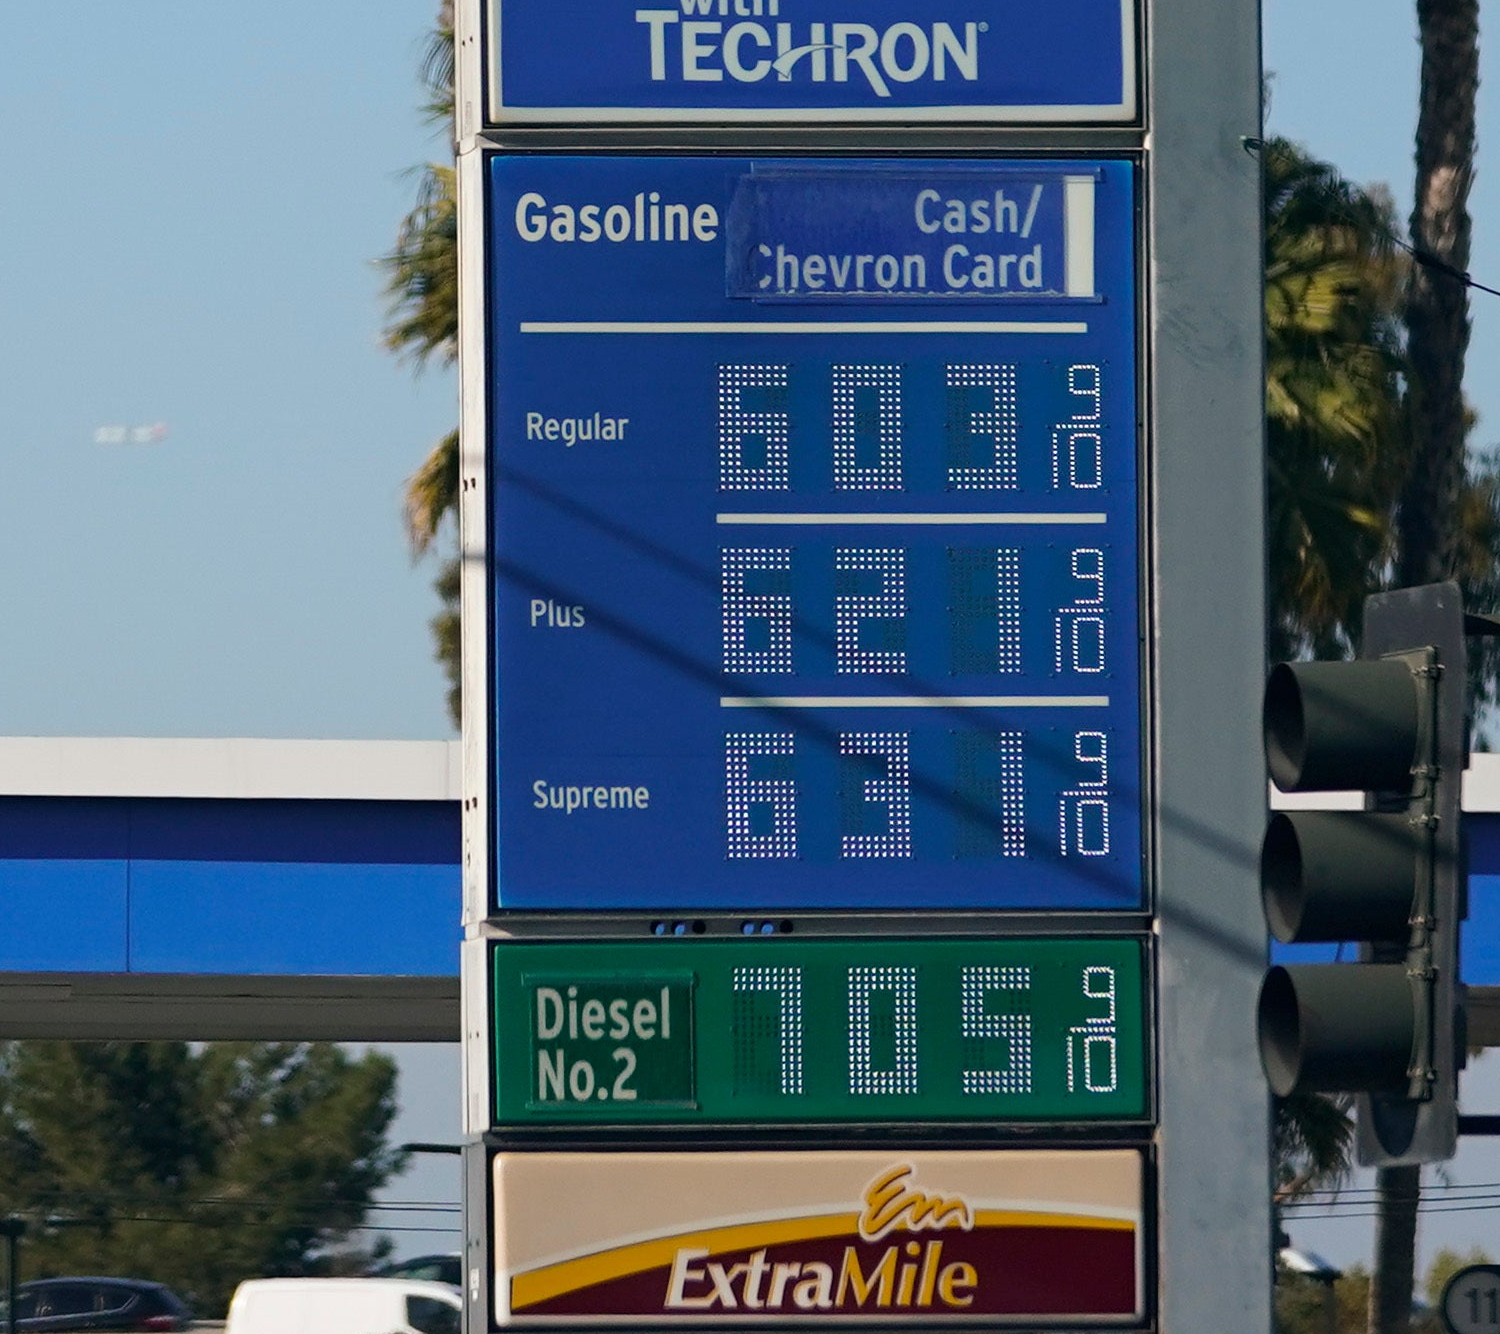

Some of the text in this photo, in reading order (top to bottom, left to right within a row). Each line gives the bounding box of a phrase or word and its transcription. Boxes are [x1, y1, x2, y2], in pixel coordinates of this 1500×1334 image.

[636, 9, 981, 97] TECHRON
[514, 192, 720, 244] Gasoline
[914, 184, 1044, 238] Cash/
[943, 243, 1043, 289] Card
[525, 411, 629, 448] Regular
[718, 364, 1018, 491] 603
[530, 598, 586, 628] Plus
[721, 547, 1021, 674] 621
[532, 779, 650, 814] Supreme
[725, 730, 1026, 858] 631
[535, 987, 672, 1041] Diesel
[732, 965, 1033, 1095] 705
[537, 1048, 638, 1101] No.2
[663, 1240, 979, 1309] ExtraMile
[1463, 1288, 1498, 1324] 11
